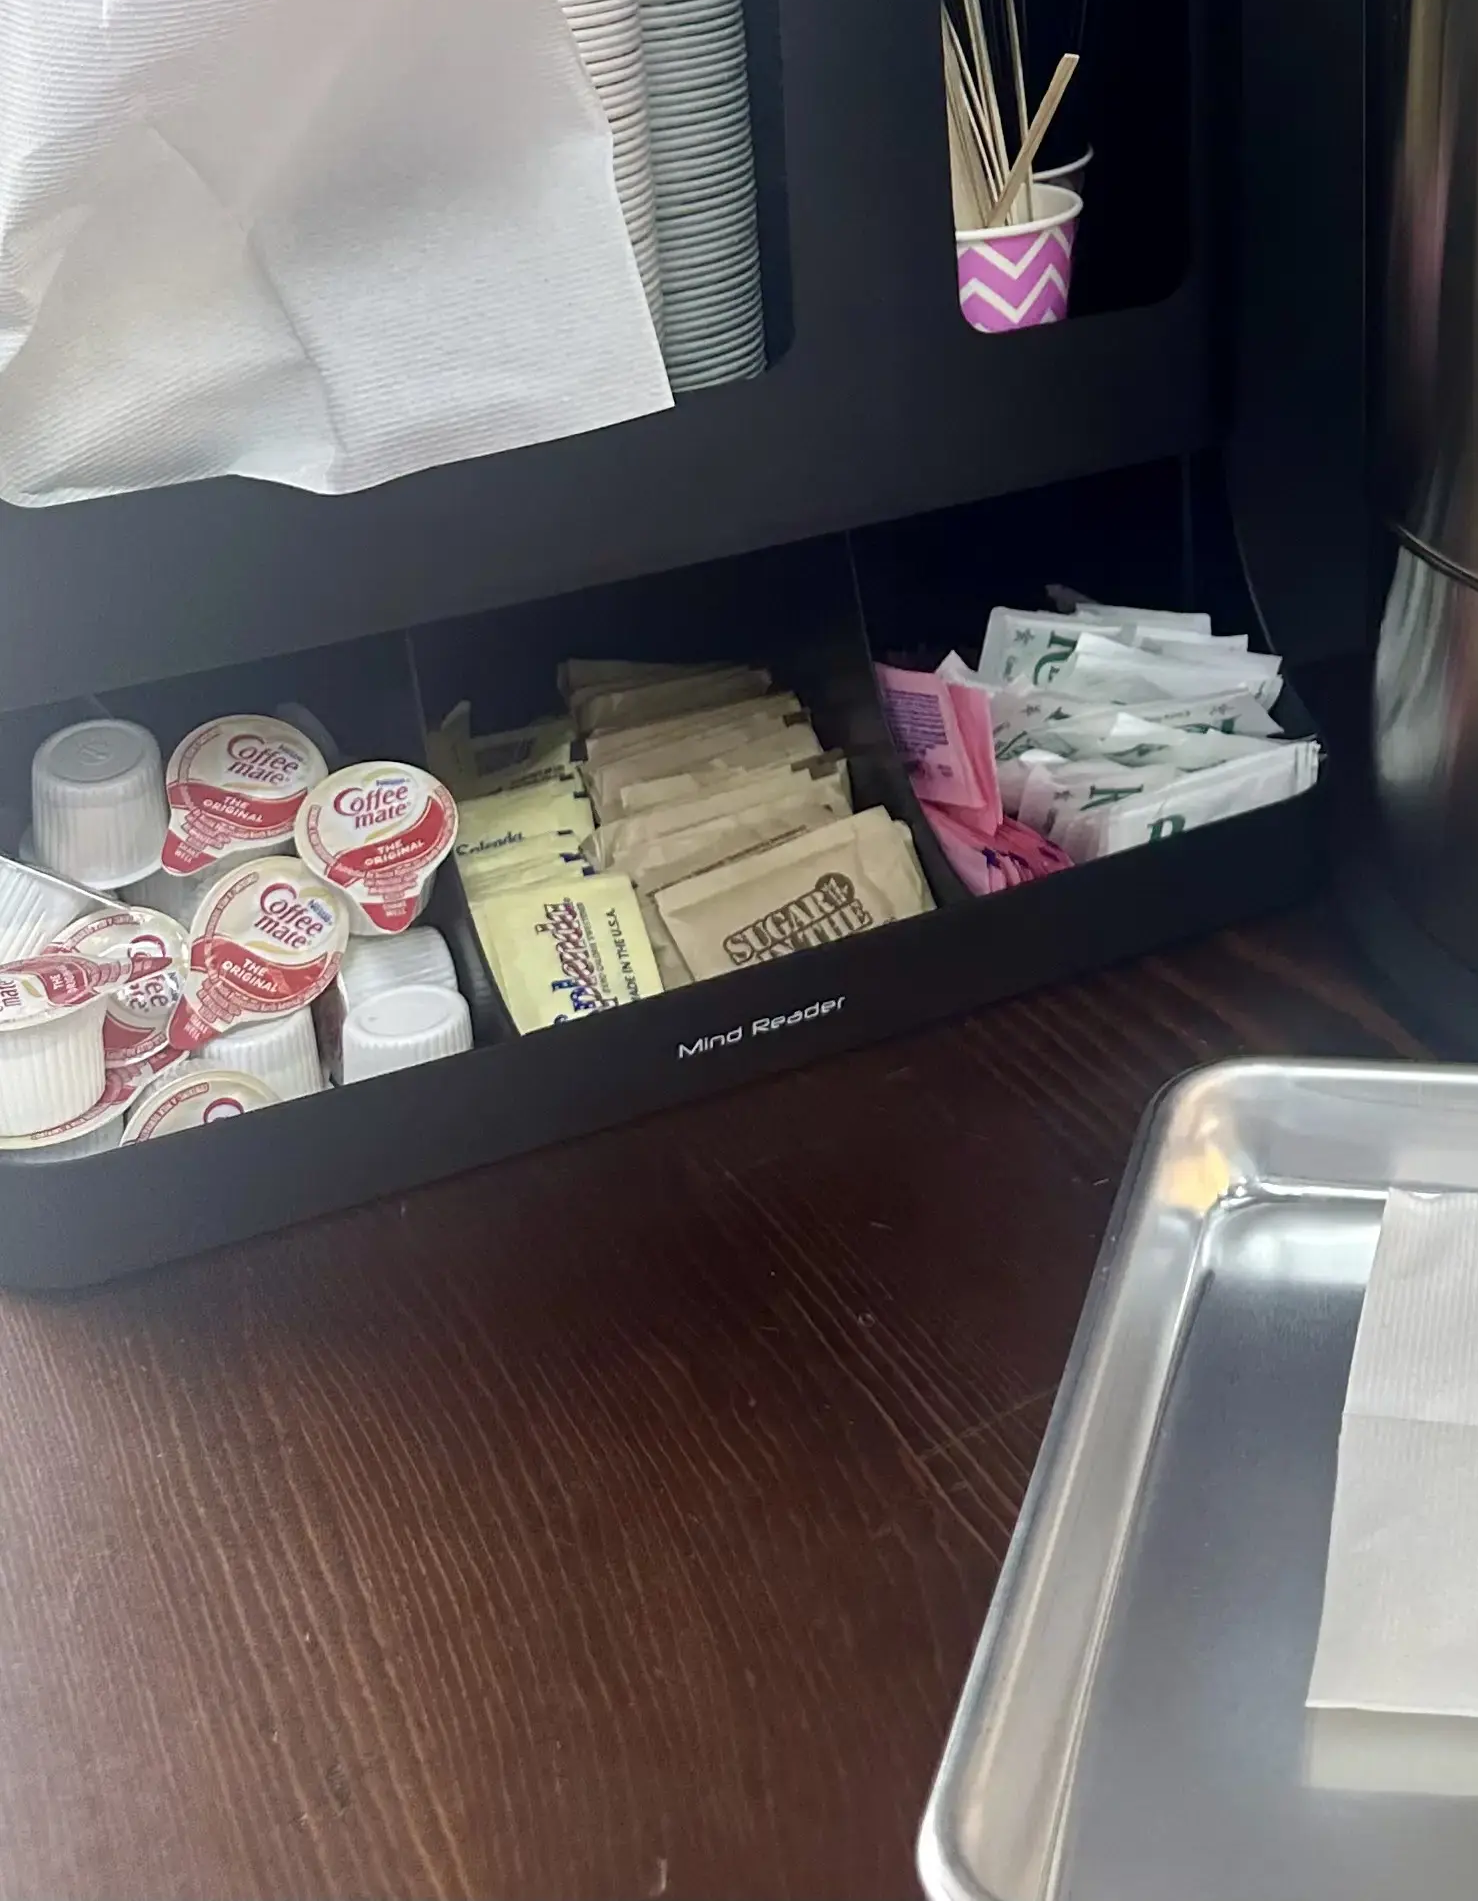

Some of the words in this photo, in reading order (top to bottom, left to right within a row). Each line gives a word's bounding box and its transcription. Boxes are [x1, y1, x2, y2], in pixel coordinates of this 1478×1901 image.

[227, 734, 299, 772] Coffee
[227, 761, 285, 785] mate
[203, 798, 264, 823] ORIGINAL
[224, 796, 250, 809] THE
[333, 785, 408, 817] Coffee
[355, 802, 408, 830] mate
[364, 839, 425, 867] ORIGINAL
[376, 839, 404, 854] THE
[260, 882, 323, 937] Coffee
[254, 915, 307, 949] mate
[726, 890, 834, 965] SUGAR
[535, 901, 619, 1025] plenda
[613, 937, 630, 959] THE
[222, 960, 278, 993] ORIGINAL
[243, 958, 268, 977] THE
[677, 1025, 743, 1059] Mind
[751, 996, 846, 1037] Reader
